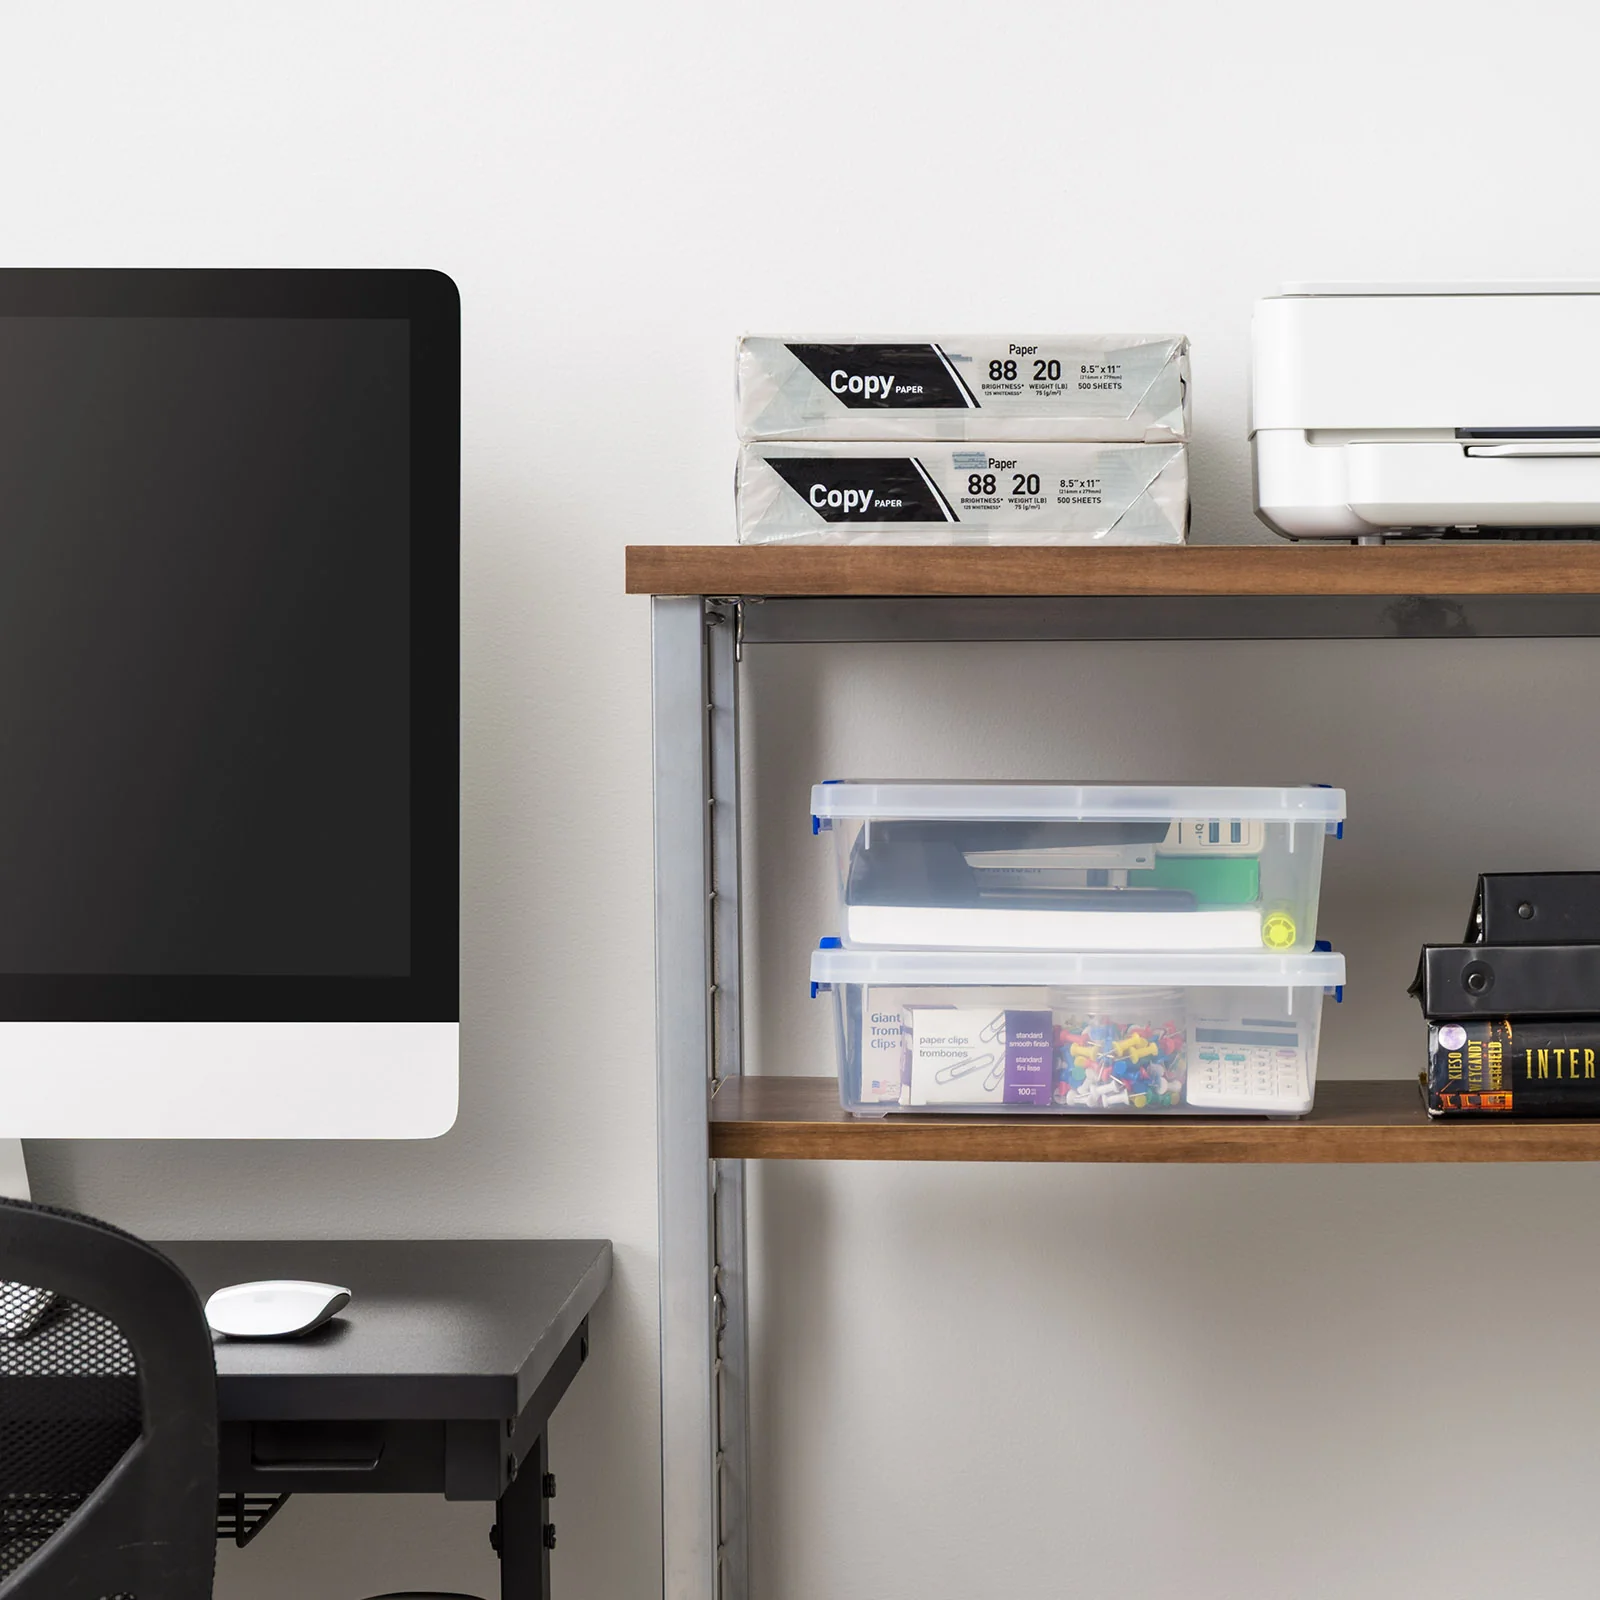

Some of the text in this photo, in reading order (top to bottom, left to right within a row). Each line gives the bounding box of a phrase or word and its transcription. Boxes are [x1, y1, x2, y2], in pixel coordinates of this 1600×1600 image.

[1009, 344, 1038, 357] Paper
[989, 359, 1061, 381] 88 20
[830, 369, 924, 399] Copy PAPER
[1078, 382, 1122, 390] 500 SHEETS
[988, 458, 1017, 471] Paper
[968, 473, 1040, 495] 88 20
[809, 483, 902, 513] Copy PAPER
[1057, 496, 1102, 504] 500 SHEETS
[871, 1012, 901, 1023] Giant
[870, 1038, 896, 1051] Clips
[919, 1035, 969, 1045] paper clips
[919, 1049, 969, 1058] trombones
[1448, 1052, 1462, 1080] KIESO
[1467, 1039, 1482, 1092] WEYGANDT
[1525, 1048, 1596, 1079] INTER
[1018, 1088, 1030, 1096] 100
